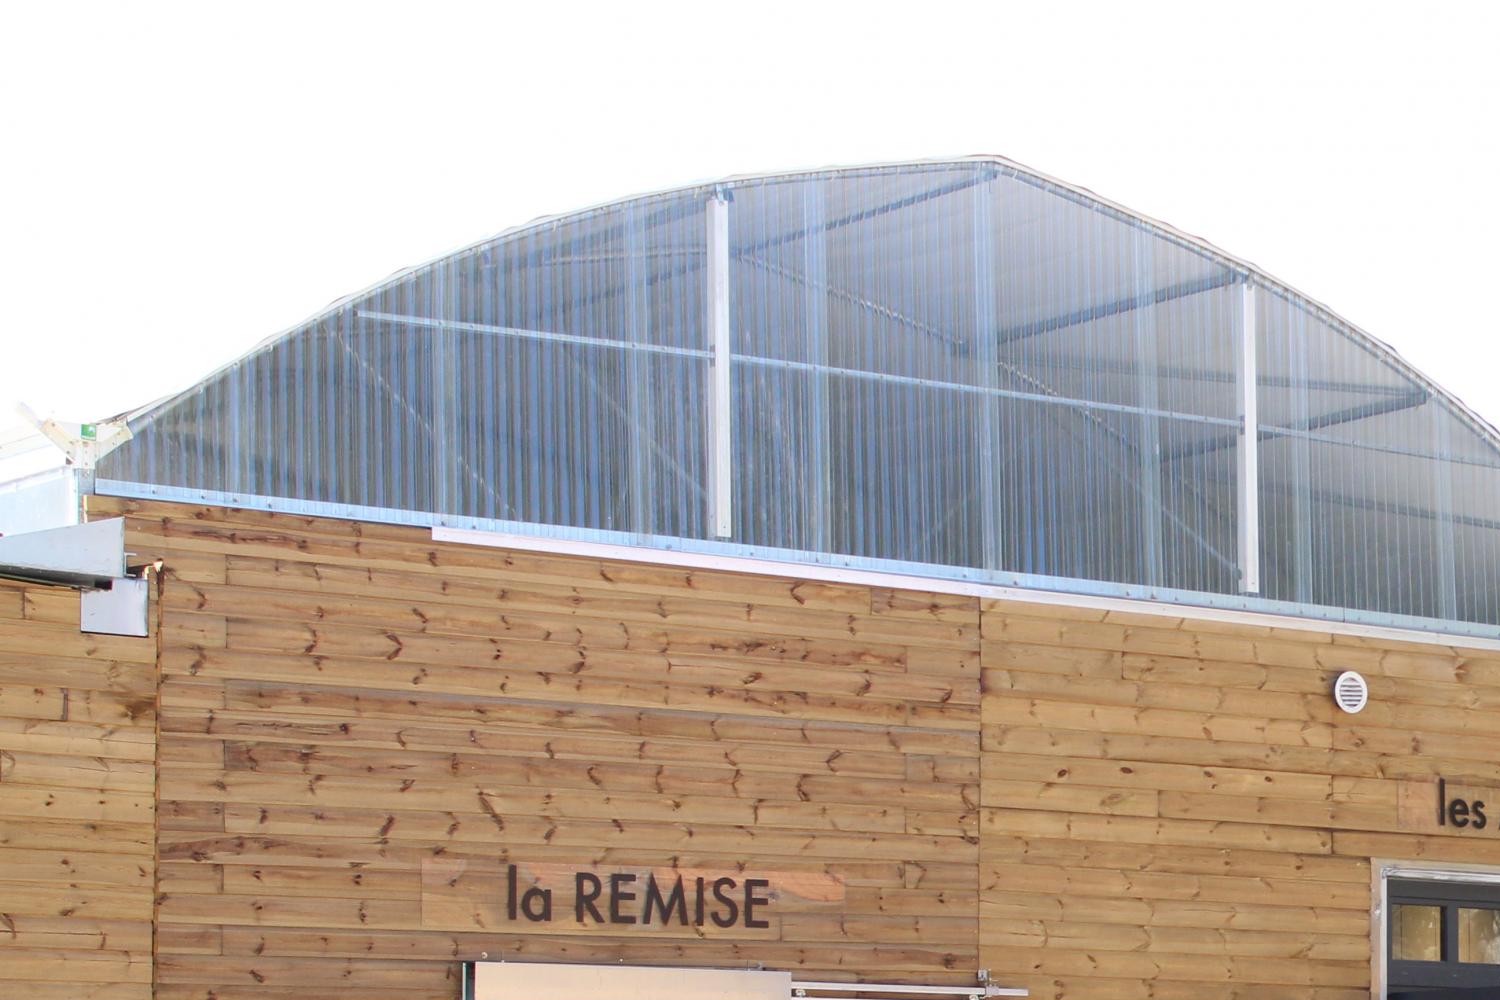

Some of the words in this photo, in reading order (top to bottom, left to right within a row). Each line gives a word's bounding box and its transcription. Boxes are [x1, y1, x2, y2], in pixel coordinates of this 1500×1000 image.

[1438, 777, 1487, 829] les
[508, 865, 551, 921] la
[575, 871, 769, 928] REMISE
